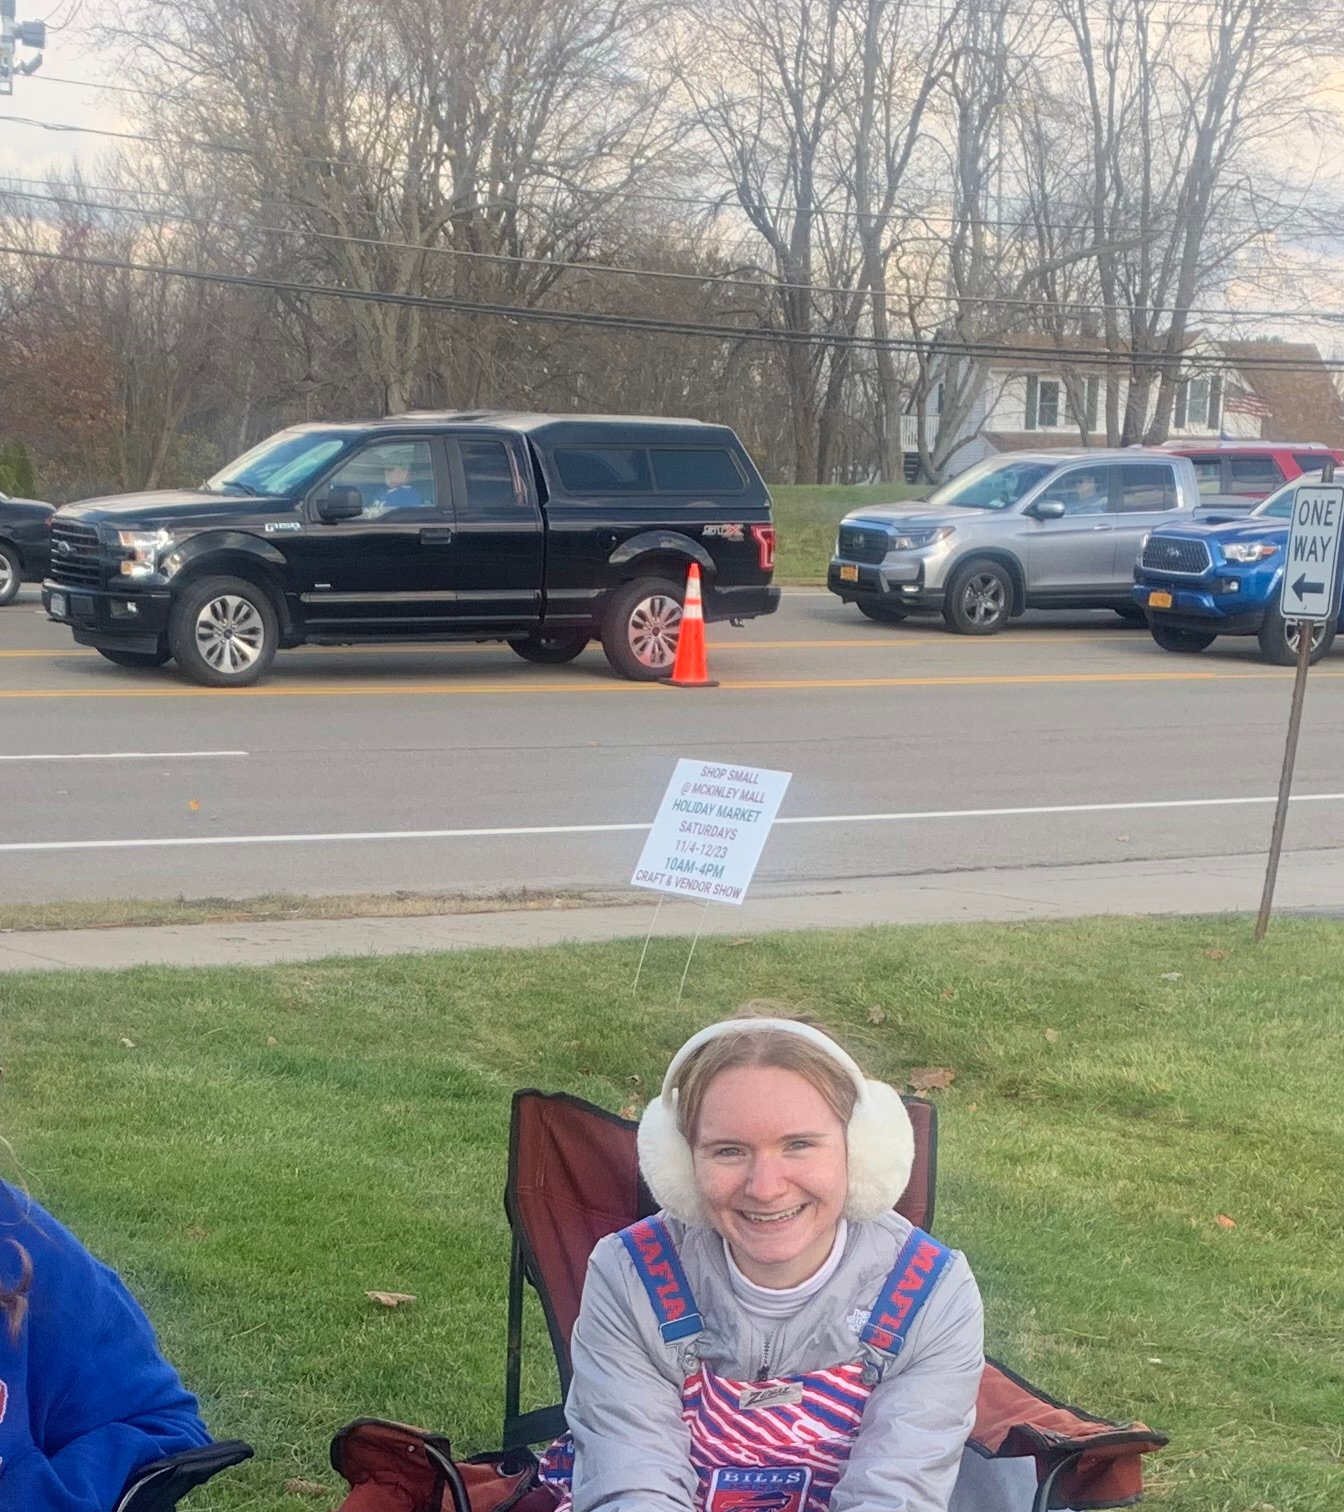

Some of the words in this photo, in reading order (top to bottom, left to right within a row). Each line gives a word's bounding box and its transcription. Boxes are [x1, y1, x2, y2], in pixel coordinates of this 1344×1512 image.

[1298, 500, 1336, 526] ONE
[1294, 535, 1332, 562] WAY
[700, 766, 727, 779] SHOP
[727, 769, 759, 785] SMALL
[681, 781, 691, 795] @
[691, 782, 739, 800] MCKINLEY
[739, 789, 766, 803] MALL
[672, 799, 716, 816] HOLIDAY
[716, 805, 762, 823] MARKET
[679, 820, 738, 841] SATURDAYS
[674, 839, 729, 859] 11/4-12/23
[664, 856, 726, 879] 10AM-4PM
[635, 869, 666, 884] CRAFT
[665, 875, 672, 886] &
[674, 876, 712, 894] VENDOR
[712, 884, 743, 899] SHOW
[868, 1238, 941, 1349] MAFIA
[723, 1470, 801, 1484] BILLS
